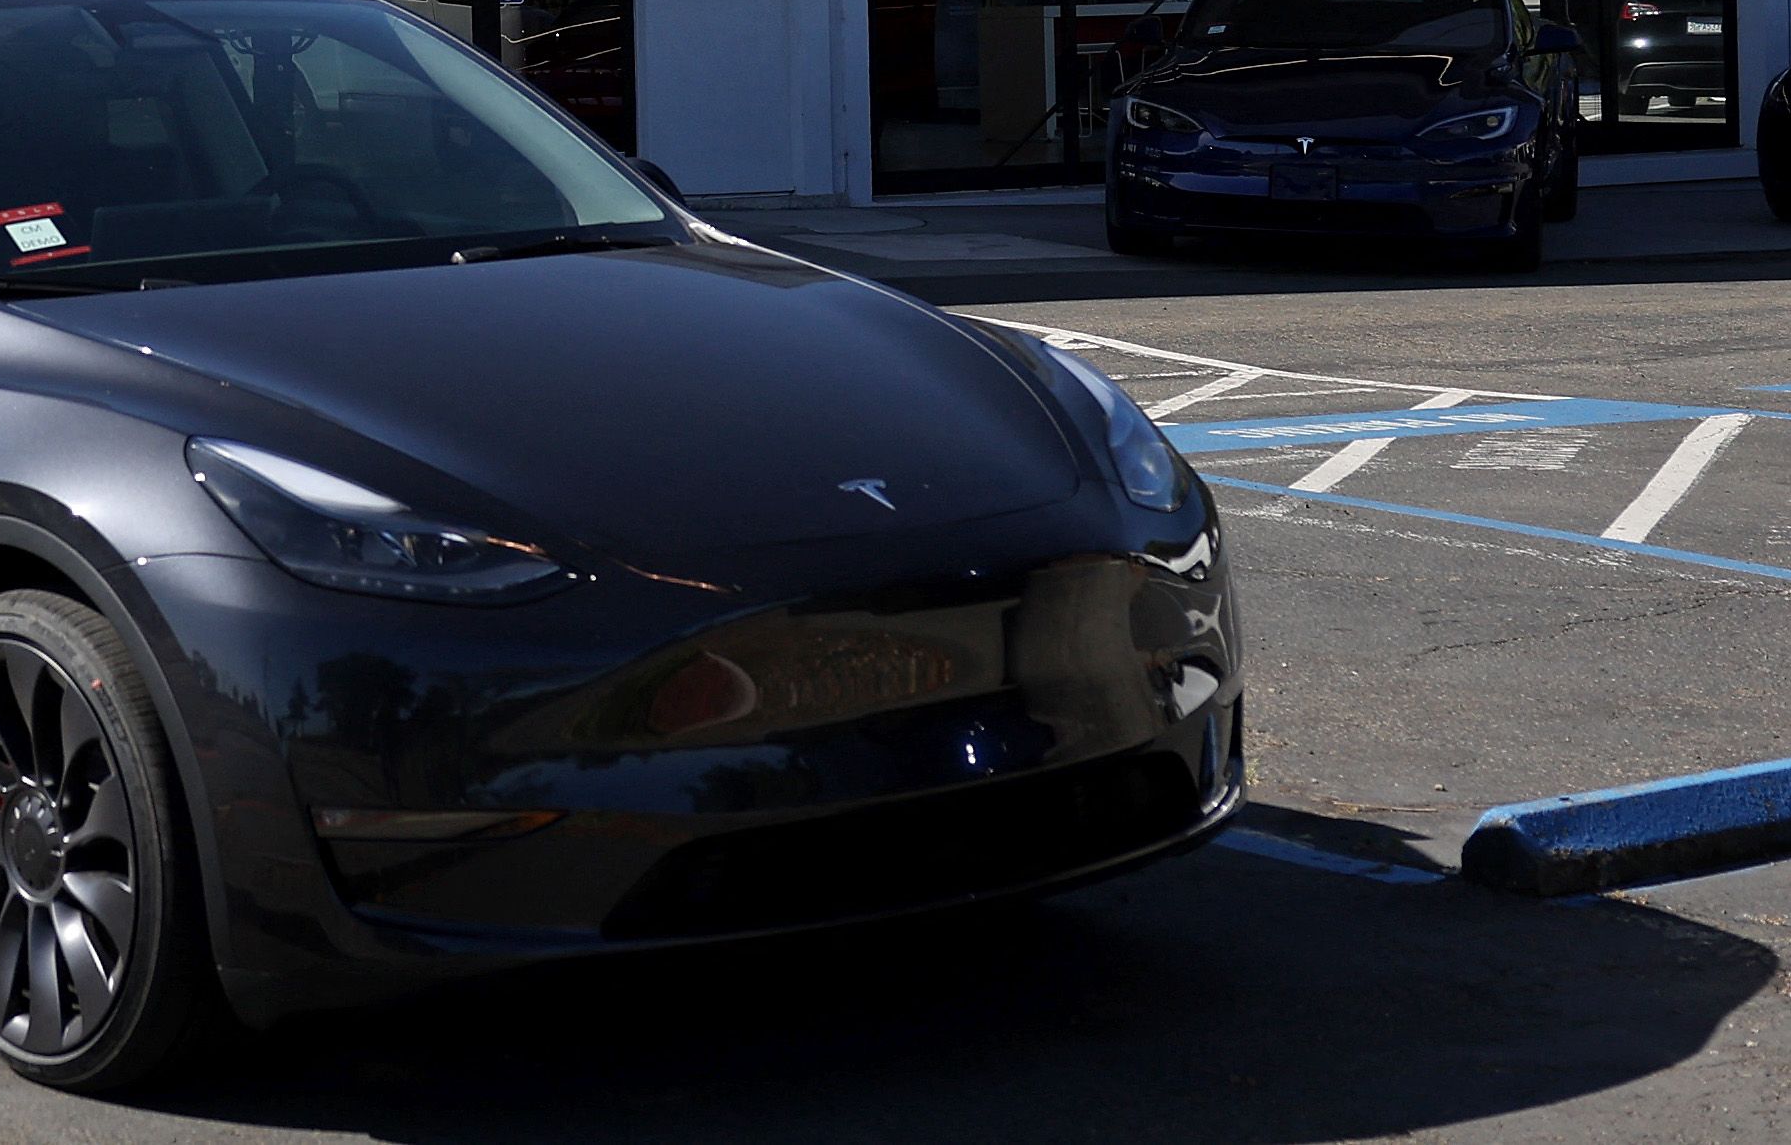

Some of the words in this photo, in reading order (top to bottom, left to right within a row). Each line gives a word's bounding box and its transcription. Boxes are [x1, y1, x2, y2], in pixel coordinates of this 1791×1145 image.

[20, 224, 43, 235] CM
[20, 235, 61, 249] DEMO
[1438, 412, 1546, 424] NO
[1207, 418, 1457, 439] PARKING
